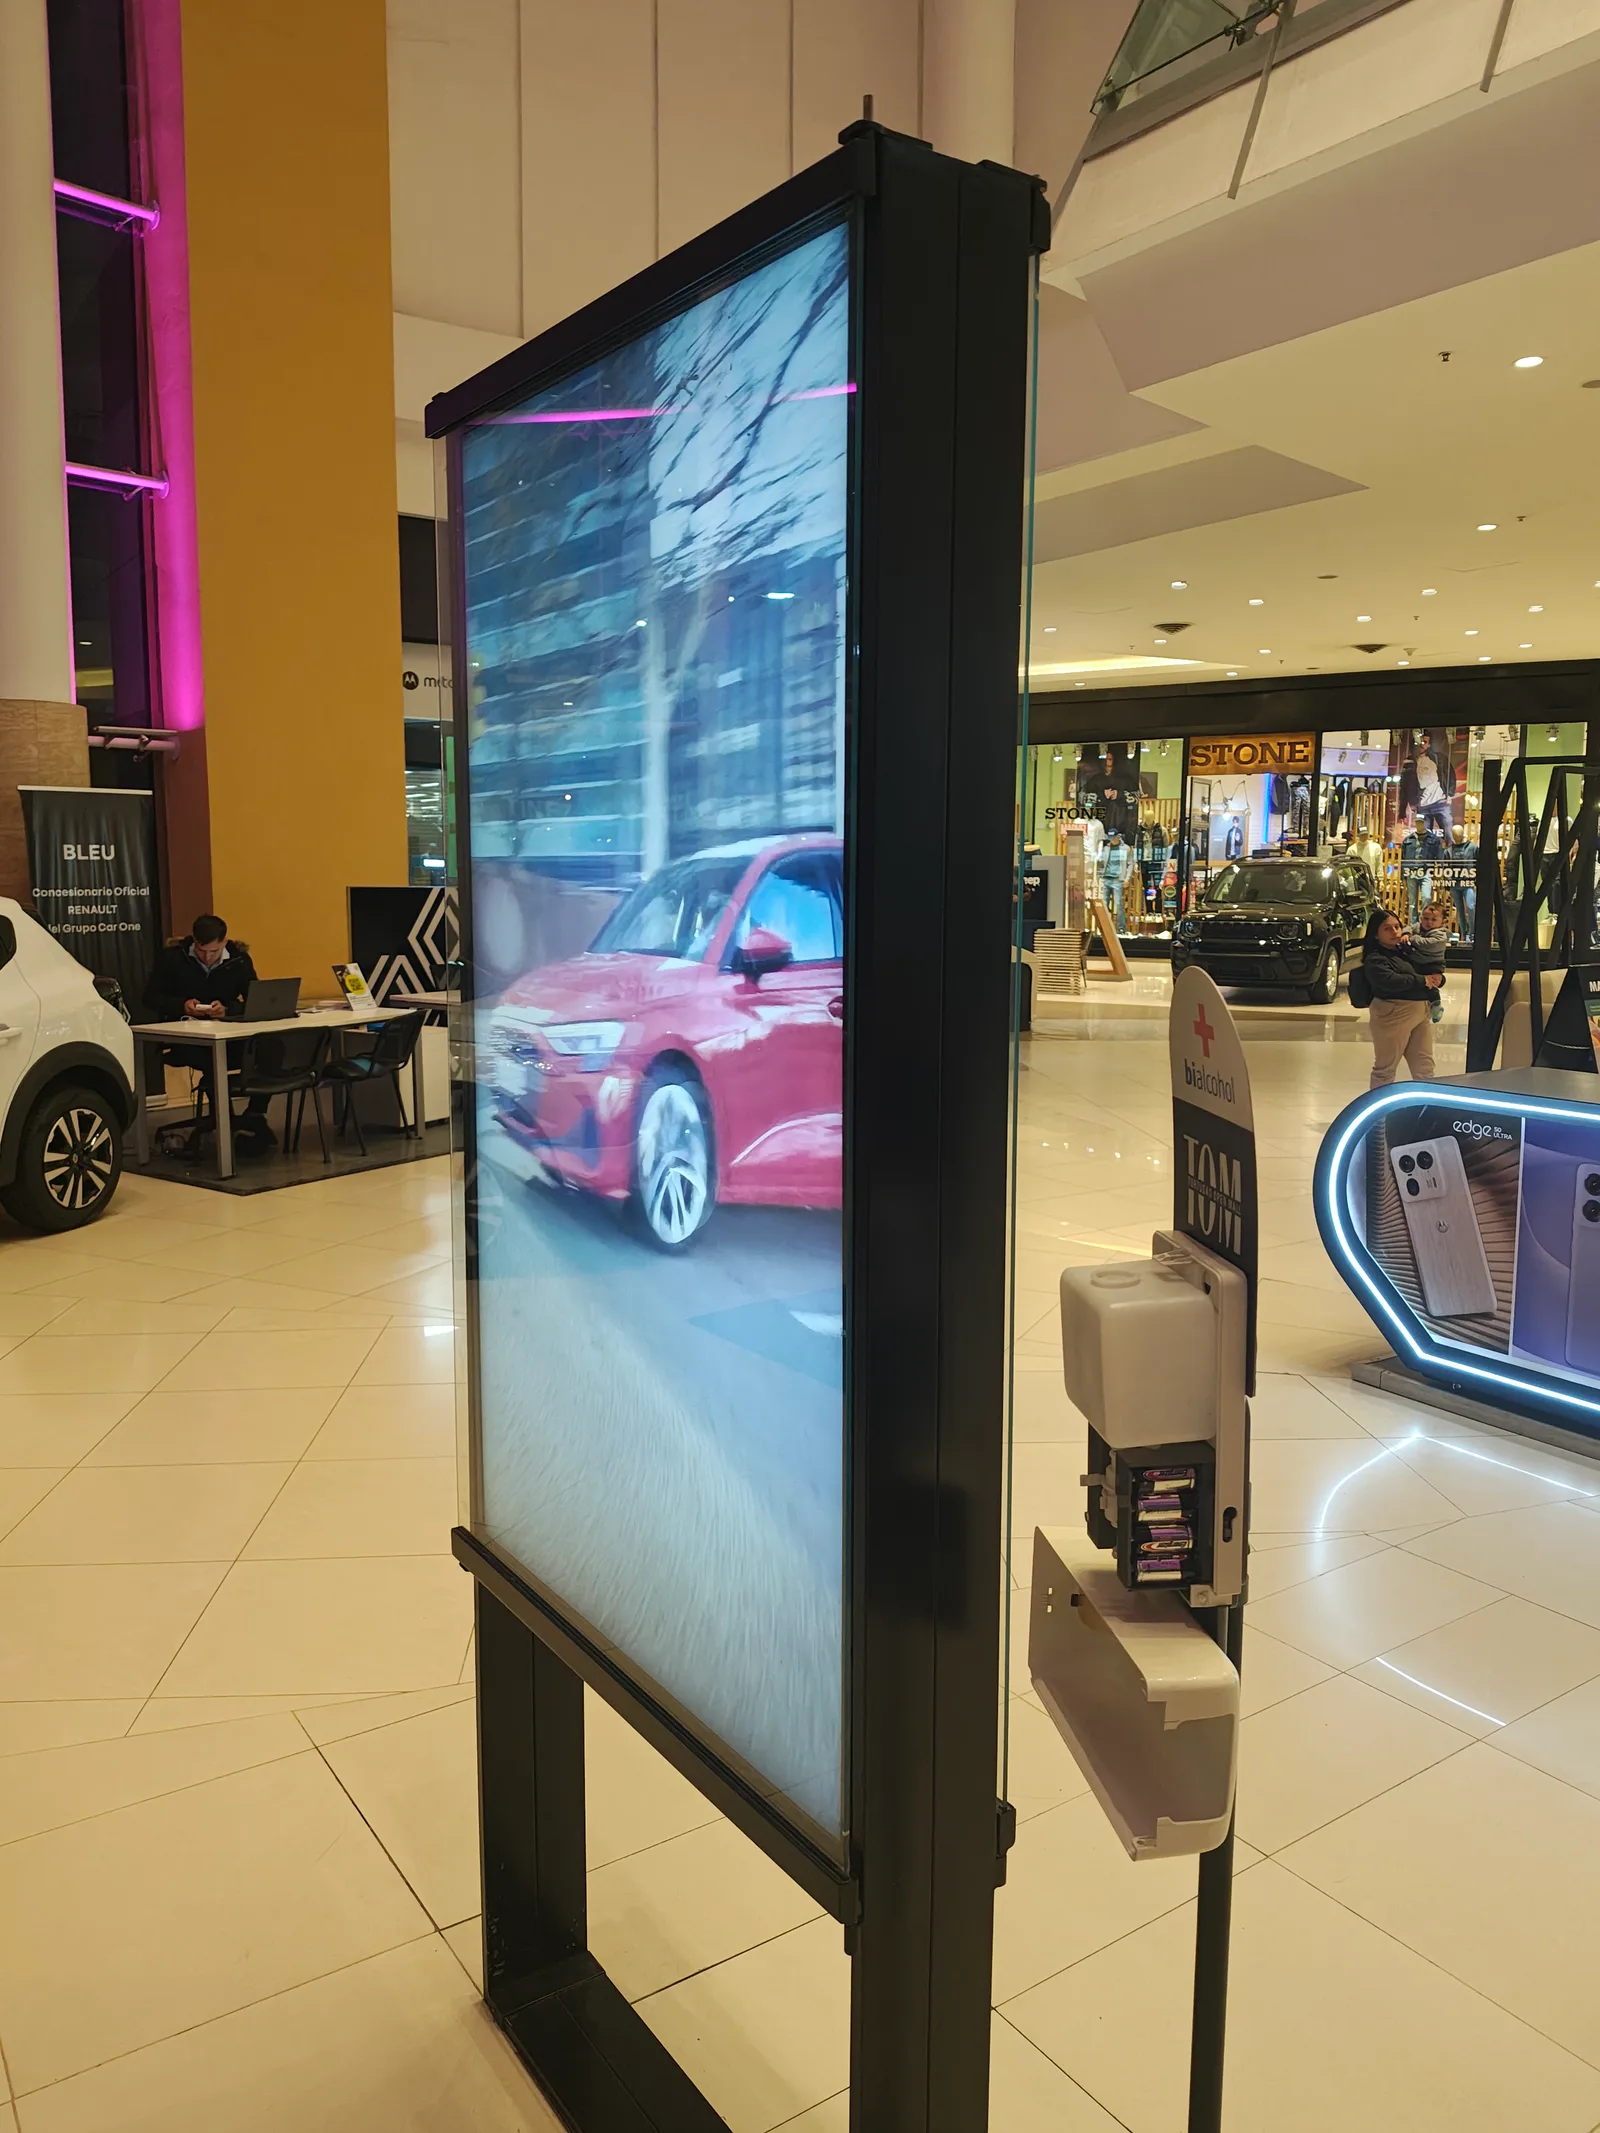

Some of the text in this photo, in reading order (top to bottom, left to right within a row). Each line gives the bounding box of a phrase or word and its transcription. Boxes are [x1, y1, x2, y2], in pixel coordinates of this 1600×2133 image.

[1190, 740, 1309, 767] STONE
[1045, 807, 1107, 820] STONE
[62, 844, 115, 861] BLEU
[1426, 867, 1477, 878] CUOTAS
[32, 886, 150, 898] Concesionario Oficial
[67, 904, 118, 915] RENAULT
[63, 923, 97, 935] Grupo
[98, 922, 118, 932] Car
[119, 922, 141, 932] One
[1184, 1057, 1236, 1105] bialcohol
[1452, 1119, 1492, 1140] edge
[1493, 1132, 1513, 1141] ULTRA
[1183, 1133, 1242, 1257] TOM
